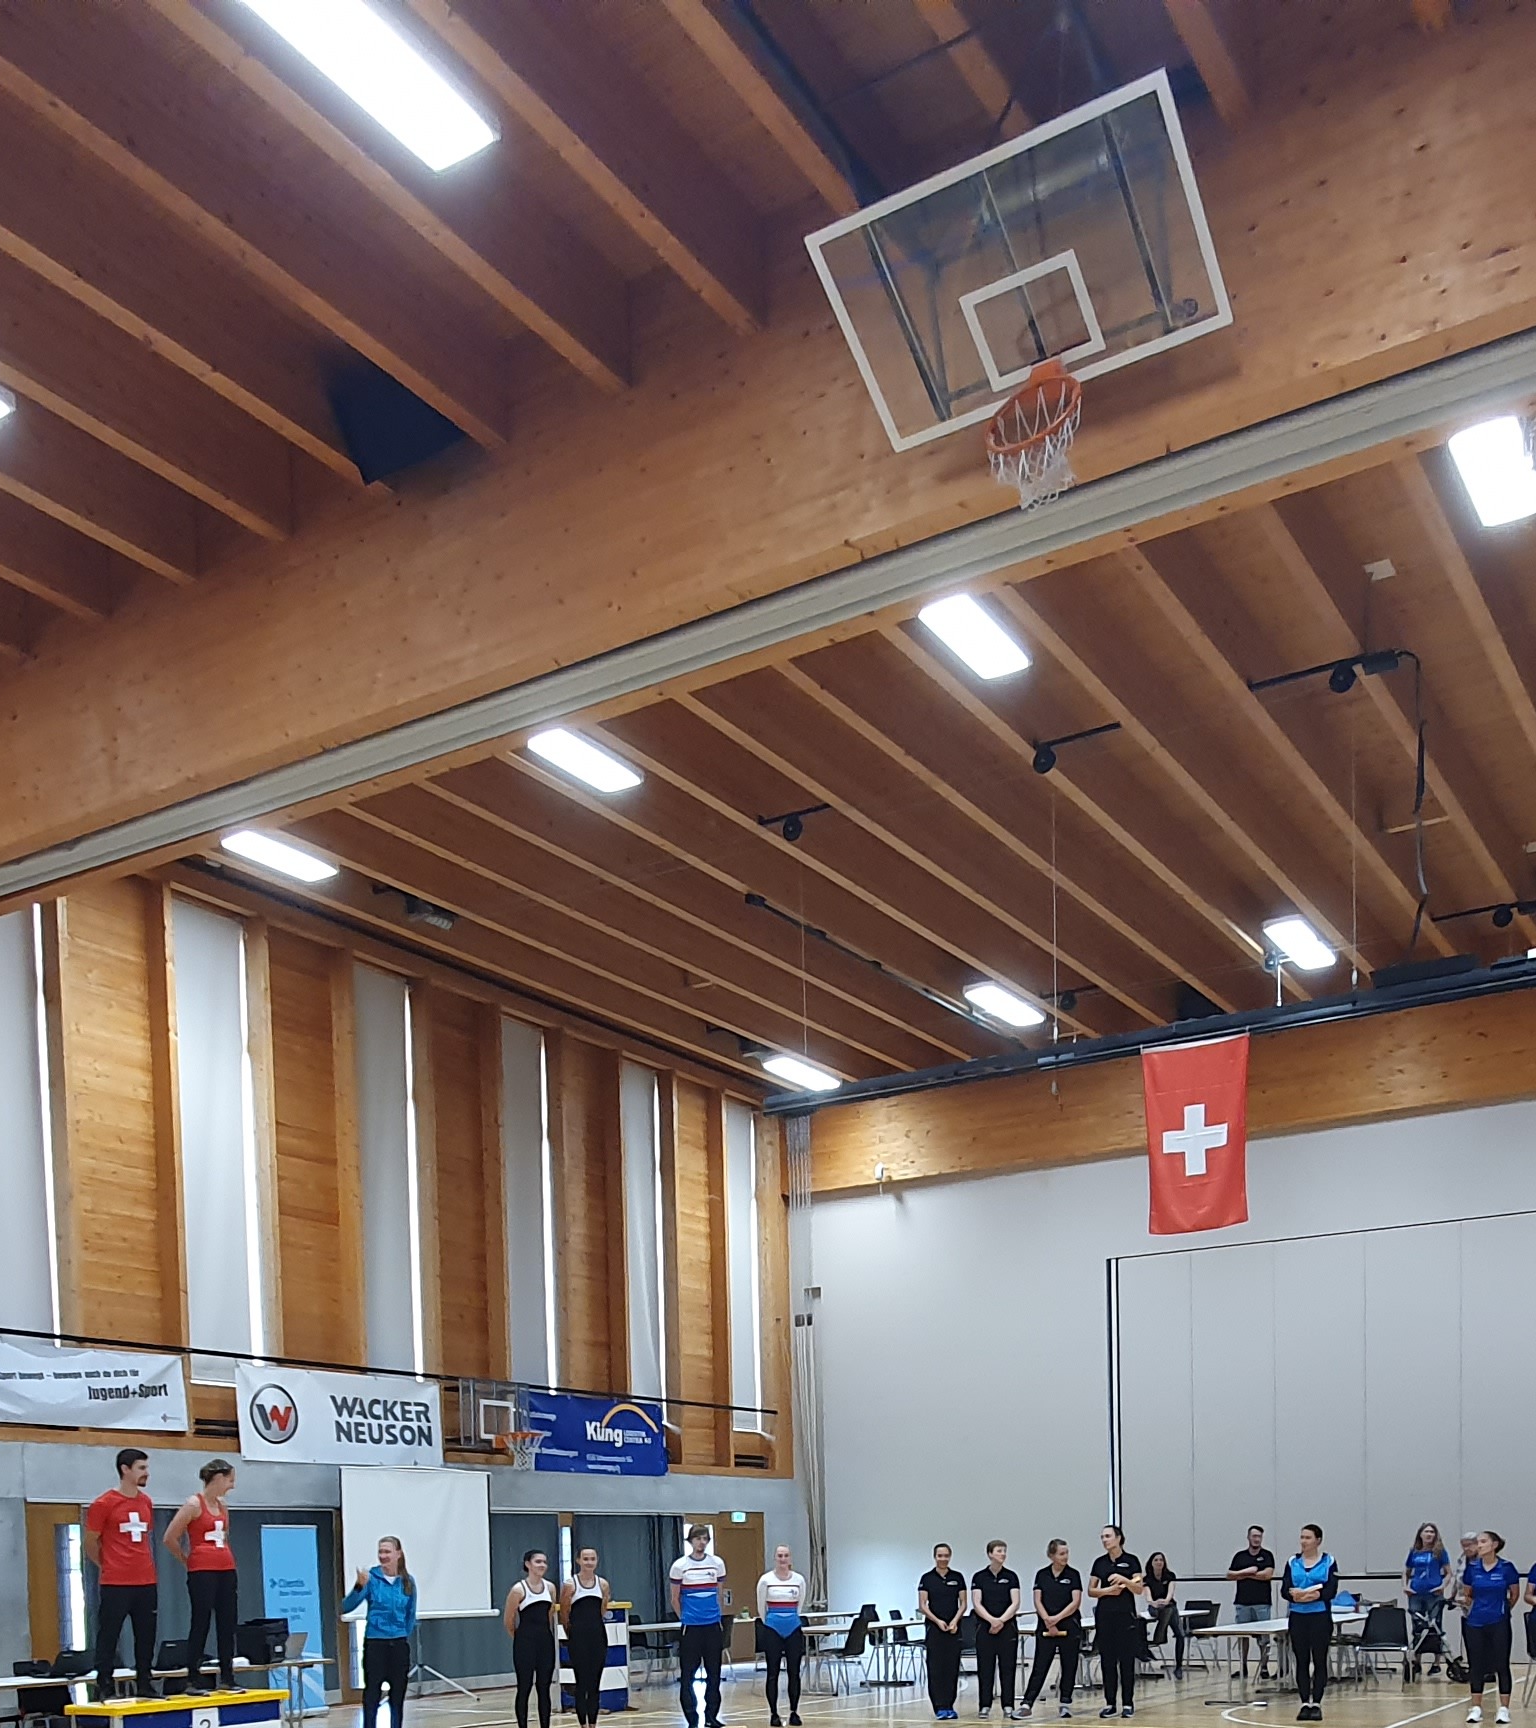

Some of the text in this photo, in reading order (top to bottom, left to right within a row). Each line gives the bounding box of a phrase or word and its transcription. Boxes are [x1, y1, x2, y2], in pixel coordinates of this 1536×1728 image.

[87, 1383, 169, 1401] Jugend+Sport
[329, 1395, 432, 1424] WACKER
[335, 1420, 433, 1447] NEUSON
